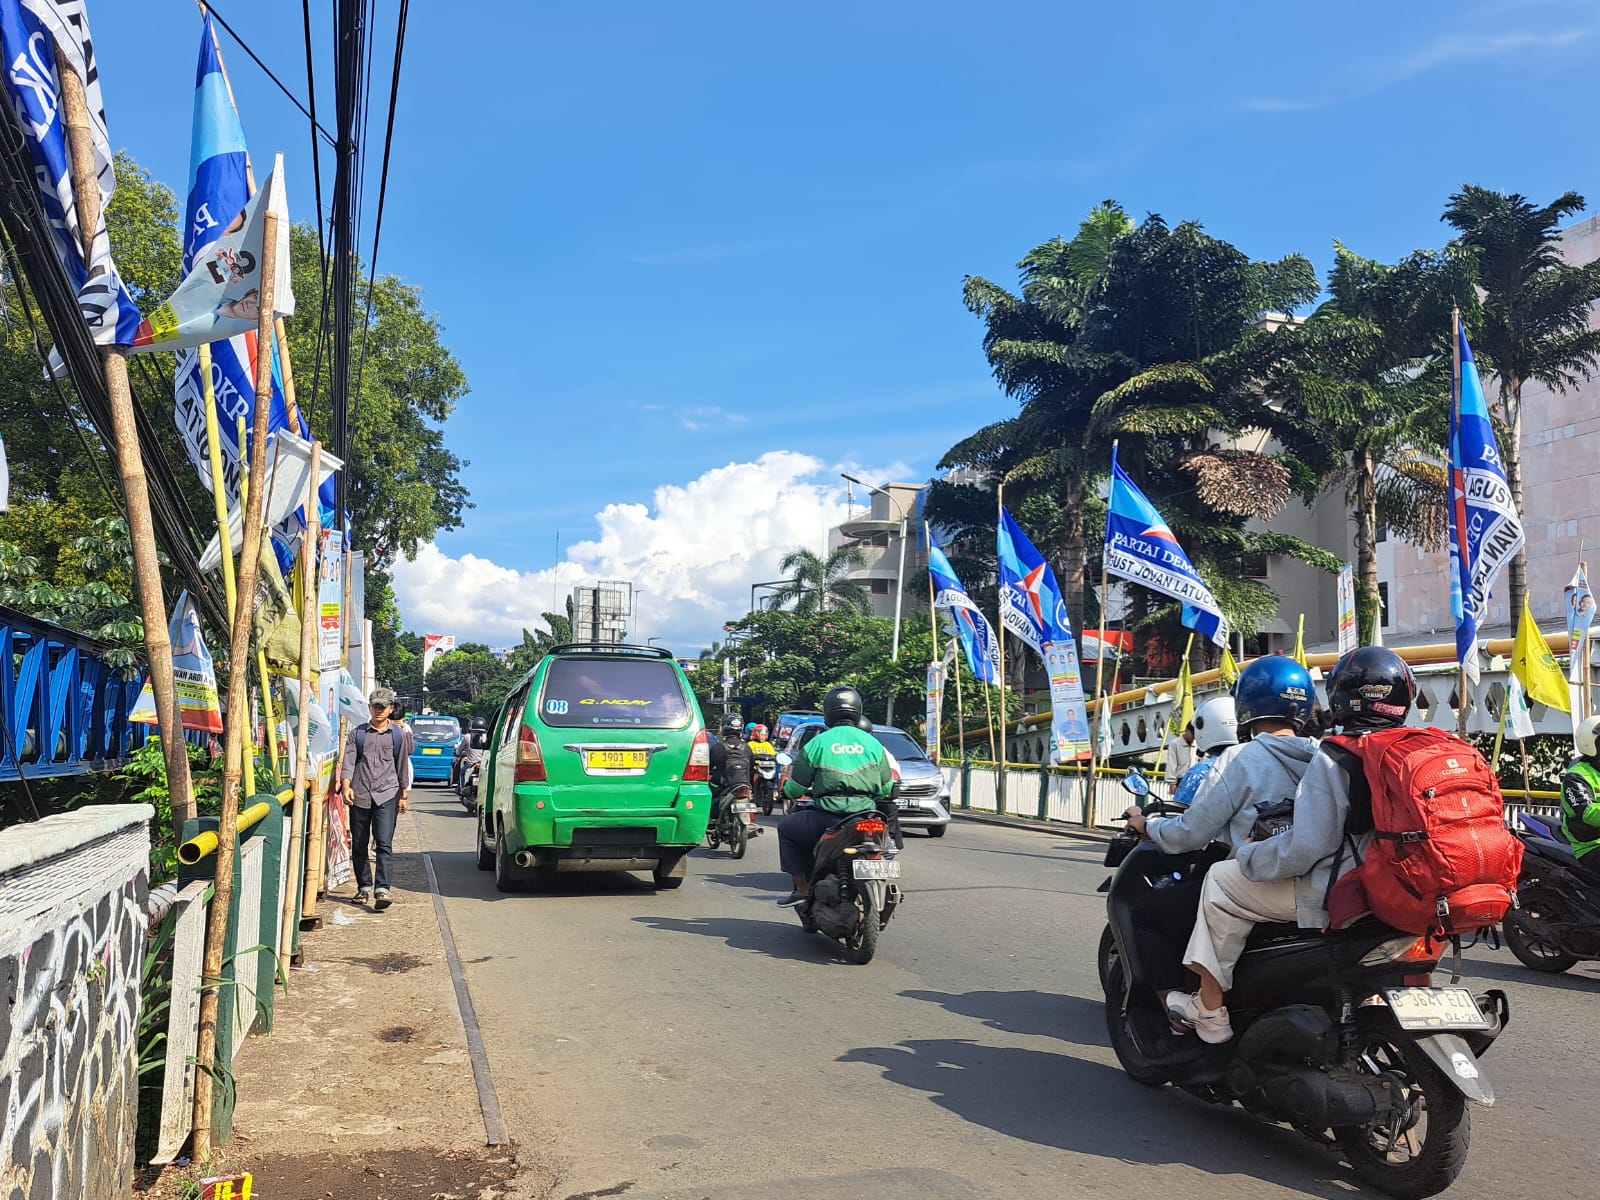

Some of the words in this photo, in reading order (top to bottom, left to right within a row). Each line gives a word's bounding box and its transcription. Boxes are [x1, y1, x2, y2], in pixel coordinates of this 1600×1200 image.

[1113, 531, 1160, 558] PARTAI
[1135, 564, 1174, 589] JOVAN
[1004, 610, 1031, 635] JOVAN
[547, 699, 568, 714] 08
[602, 752, 624, 762] 1901
[633, 752, 644, 762] BD
[831, 742, 865, 755] Grab
